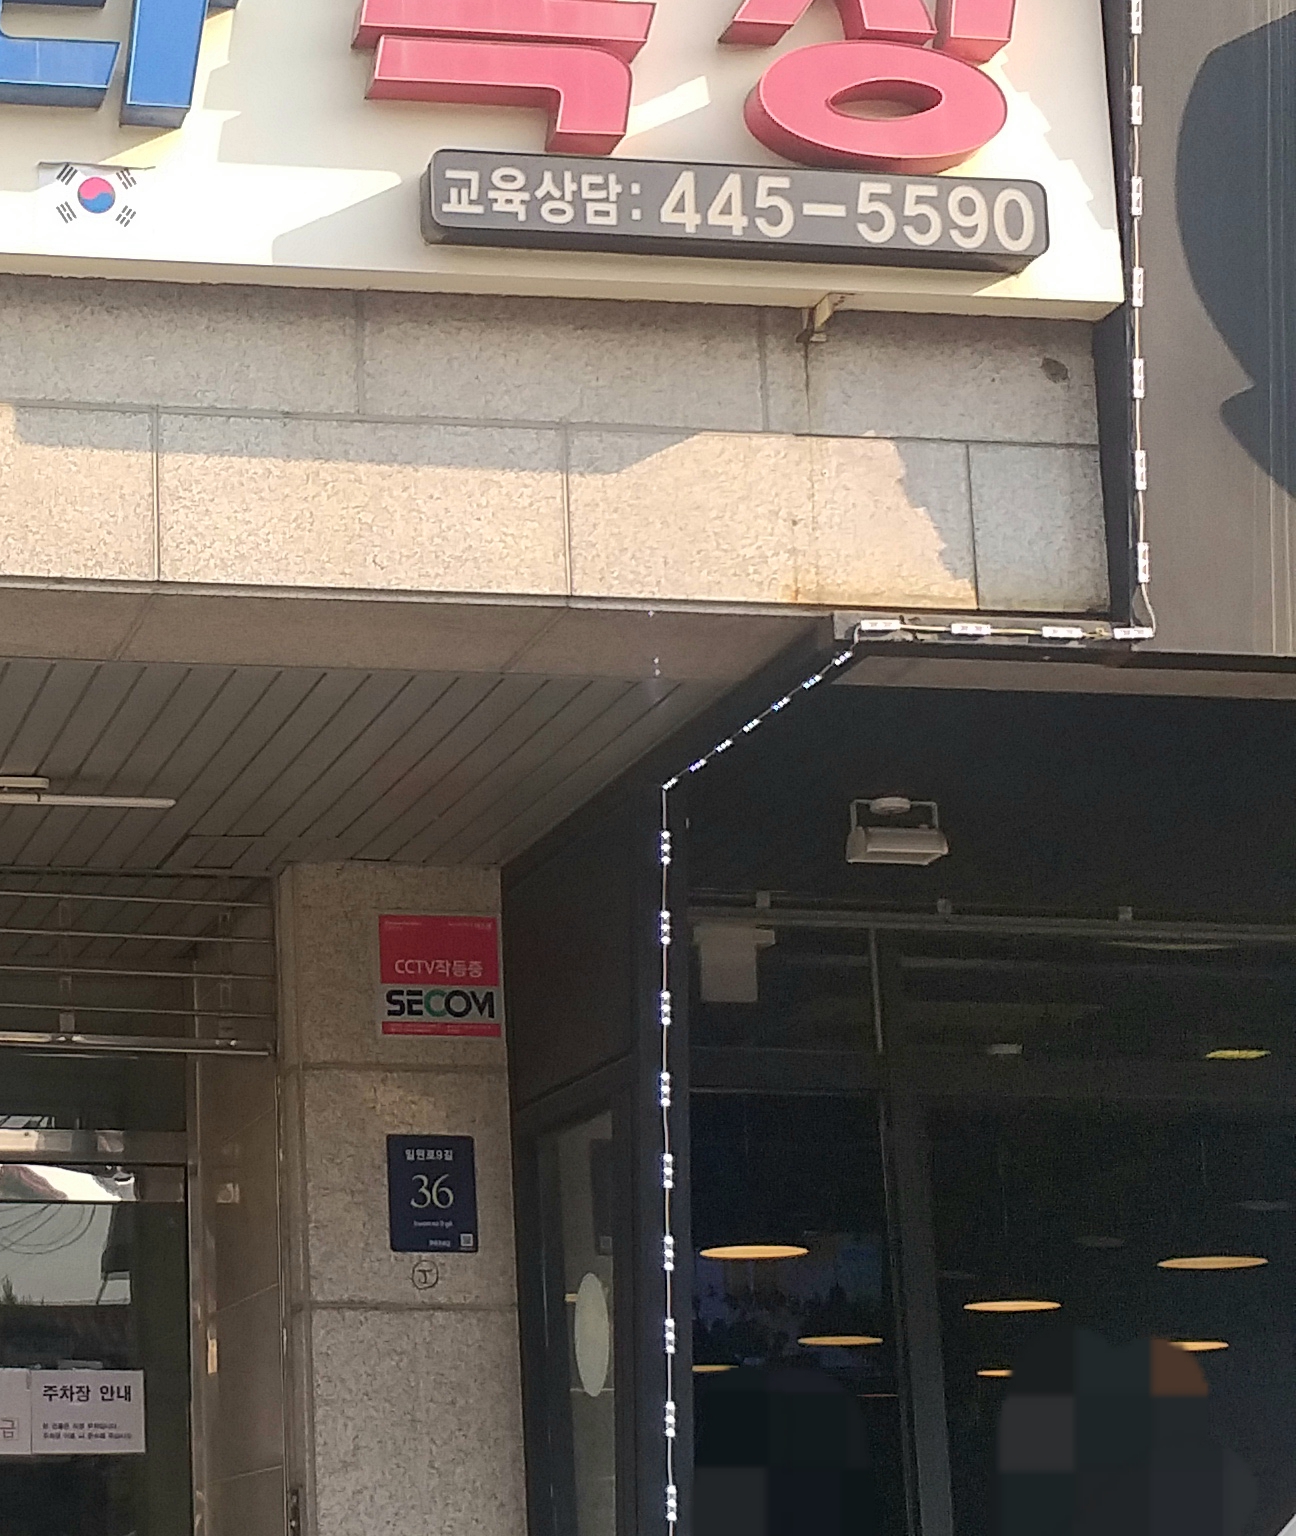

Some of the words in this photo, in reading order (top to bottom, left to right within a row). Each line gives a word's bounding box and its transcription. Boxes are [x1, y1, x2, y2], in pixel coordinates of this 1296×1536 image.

[659, 169, 1035, 252] 445-5590
[394, 959, 483, 978] CCTV작동중
[386, 989, 495, 1019] SECOM
[410, 1173, 454, 1209] 36
[42, 1384, 91, 1403] 주차장
[99, 1384, 132, 1403] 안내
